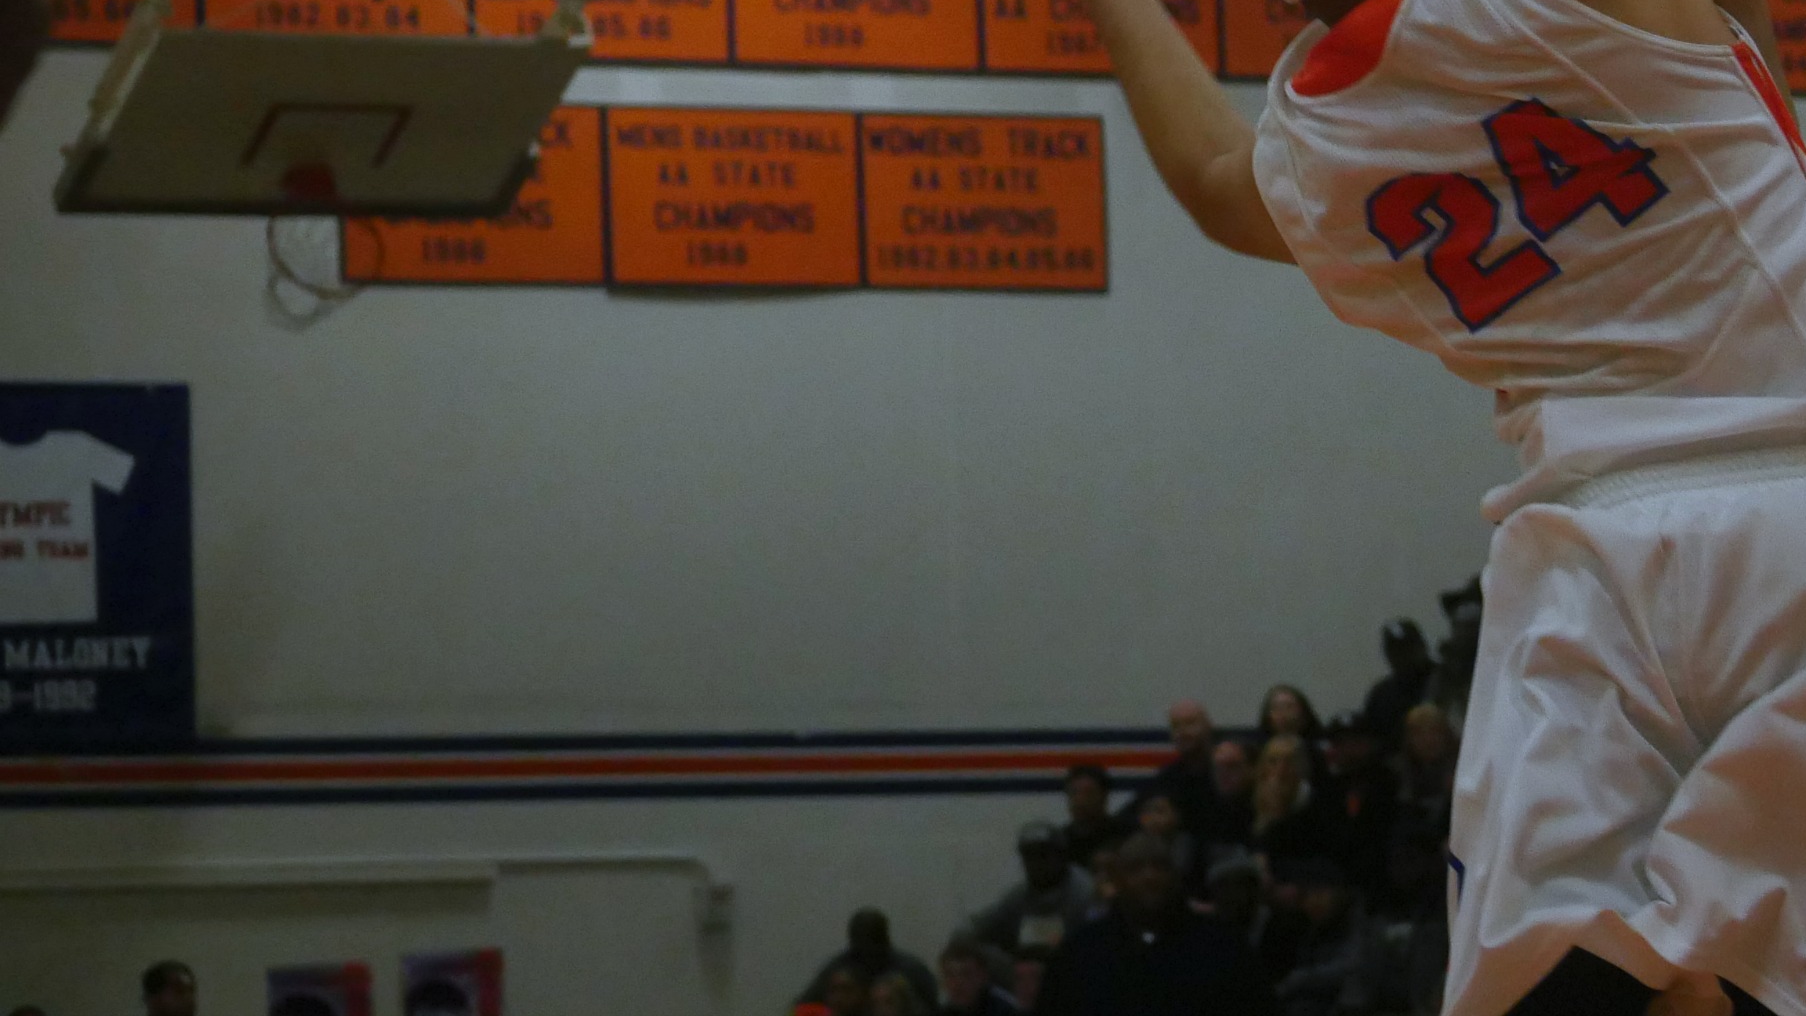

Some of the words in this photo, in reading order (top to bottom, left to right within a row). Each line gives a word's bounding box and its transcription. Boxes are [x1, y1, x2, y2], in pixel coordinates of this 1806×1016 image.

[616, 123, 683, 150] MENS
[693, 126, 845, 155] BASKETBALL
[870, 127, 982, 158] WOMENS
[1007, 129, 1091, 161] TRACK
[712, 160, 797, 190] STATE
[958, 166, 1038, 195] STATE
[654, 201, 816, 235] CHAMPIONS
[902, 206, 1058, 239] CHAMPIONS
[1365, 96, 1669, 333] 24
[4, 636, 151, 671] MALONEY
